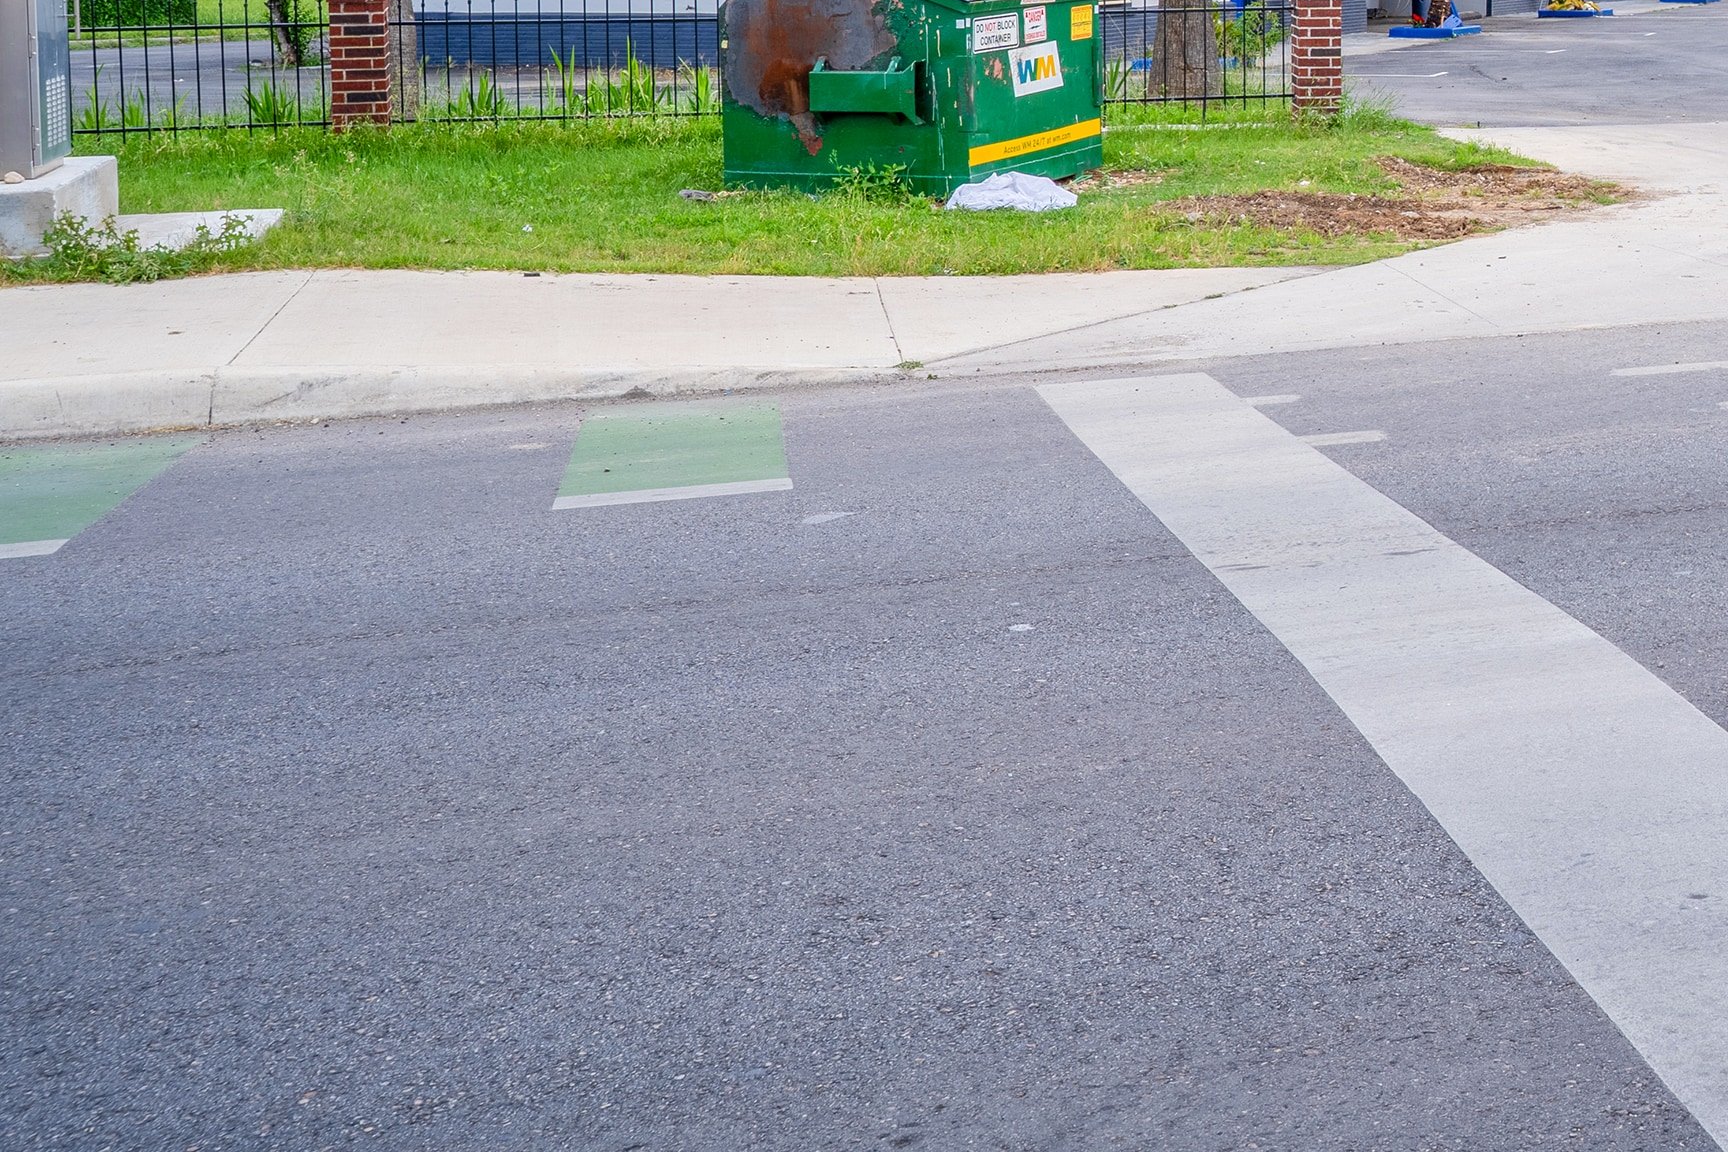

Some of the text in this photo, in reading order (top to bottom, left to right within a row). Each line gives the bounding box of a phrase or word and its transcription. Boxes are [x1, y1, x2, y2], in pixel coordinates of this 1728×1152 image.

[976, 19, 1016, 34] DO NOT BLOCK
[980, 32, 1012, 46] CONTAINER
[1017, 54, 1056, 84] WM
[1021, 140, 1032, 150] WM
[1032, 136, 1045, 148] 24/7
